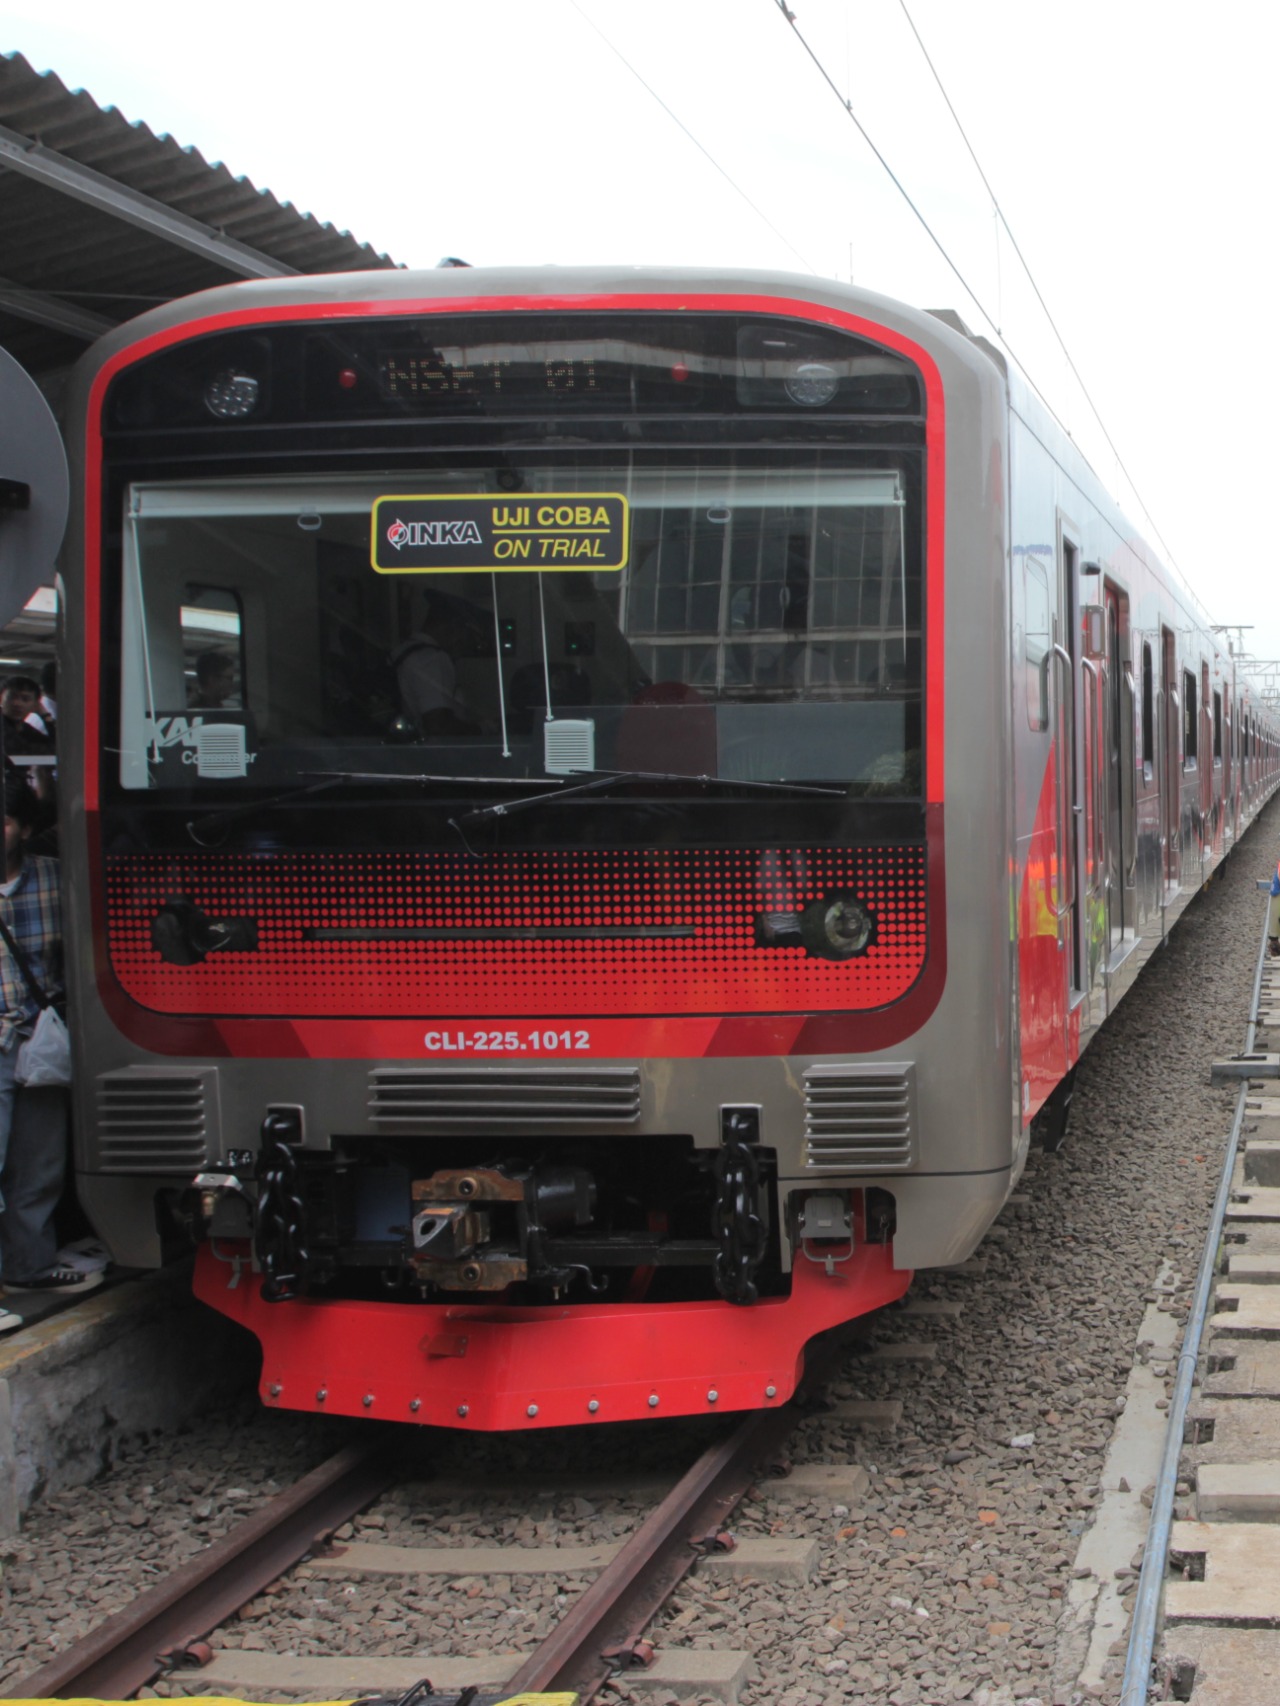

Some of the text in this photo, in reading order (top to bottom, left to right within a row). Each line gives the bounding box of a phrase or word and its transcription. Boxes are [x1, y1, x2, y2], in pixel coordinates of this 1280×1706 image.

[492, 506, 610, 526] UJI COBA
[408, 520, 482, 545] INKA
[494, 538, 606, 558] ON TRIAL
[424, 1030, 590, 1050] CLI-225.1012
